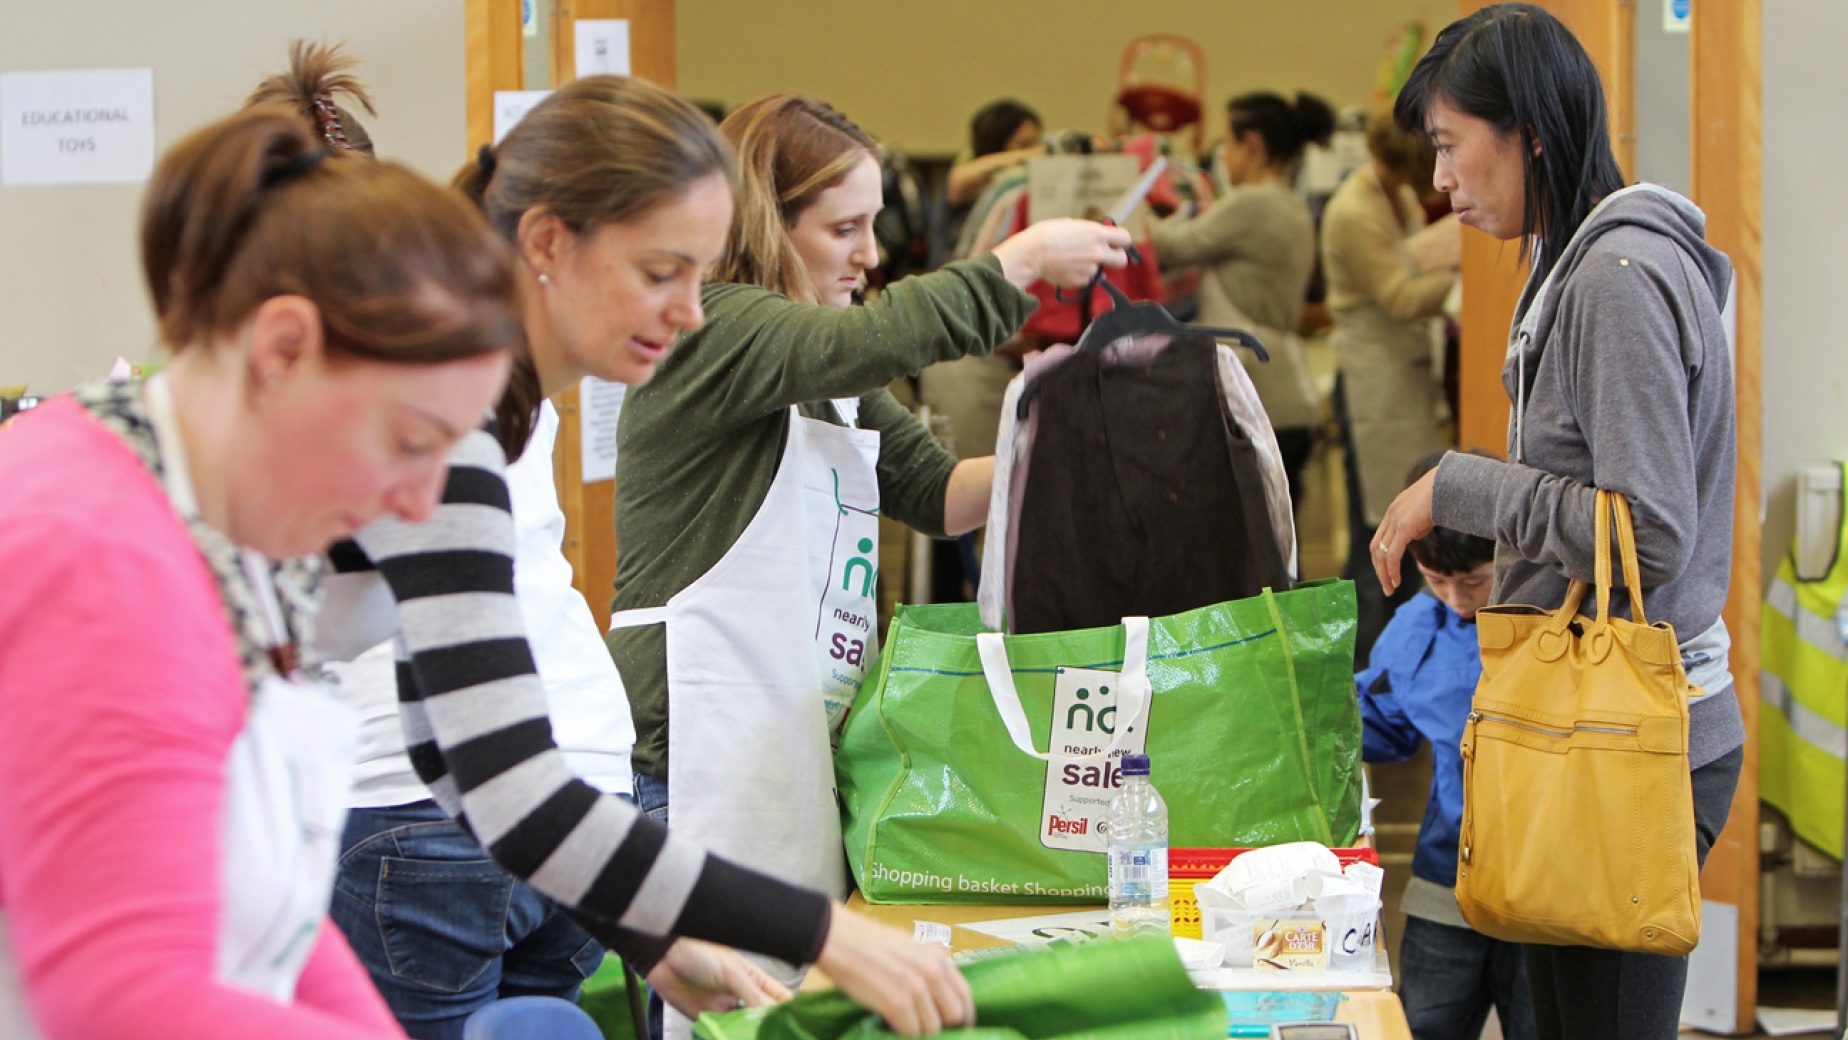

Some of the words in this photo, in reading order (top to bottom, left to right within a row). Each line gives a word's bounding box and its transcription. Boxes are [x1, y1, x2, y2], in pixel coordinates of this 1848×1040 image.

[22, 108, 129, 125] EDUCATIONAL
[57, 136, 96, 152] TOYS
[833, 608, 870, 632] nearly
[829, 632, 864, 672] sa
[1064, 744, 1102, 756] nearl
[1062, 761, 1123, 789] sale
[1069, 795, 1110, 807] Supported
[1048, 815, 1088, 836] Persil
[872, 861, 953, 893] Shopping
[958, 873, 1019, 895] basket
[1285, 931, 1319, 944] CARTE
[1288, 941, 1315, 952] D'OR
